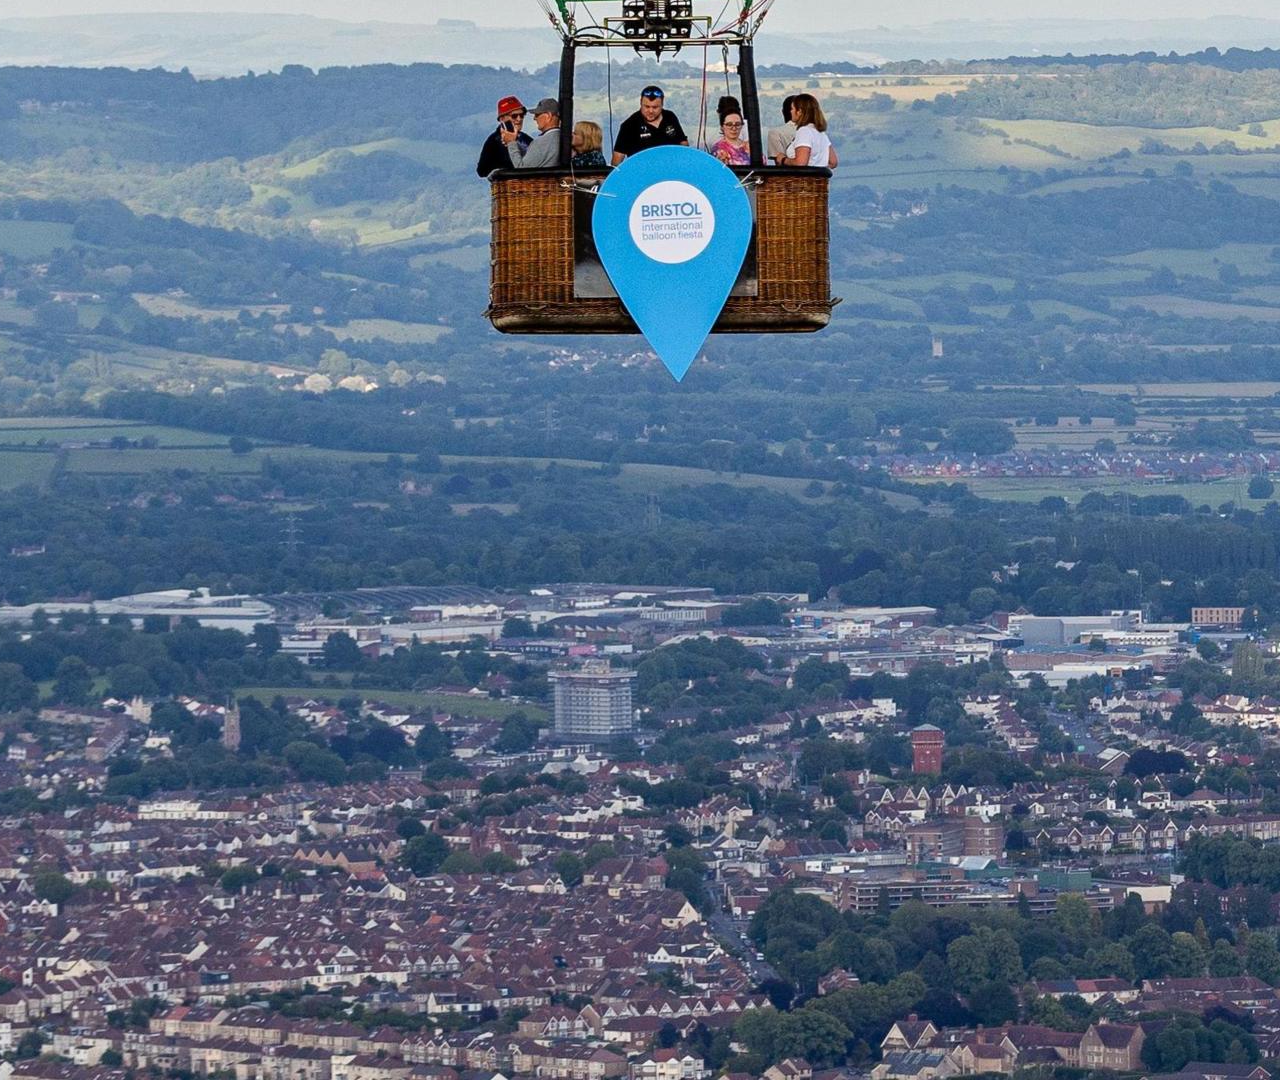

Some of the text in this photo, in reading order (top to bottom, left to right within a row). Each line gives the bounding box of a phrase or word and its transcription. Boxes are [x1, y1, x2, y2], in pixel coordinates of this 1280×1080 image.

[641, 202, 702, 217] BRISTOL
[642, 221, 703, 232] international
[642, 230, 703, 241] balloon fiesta
